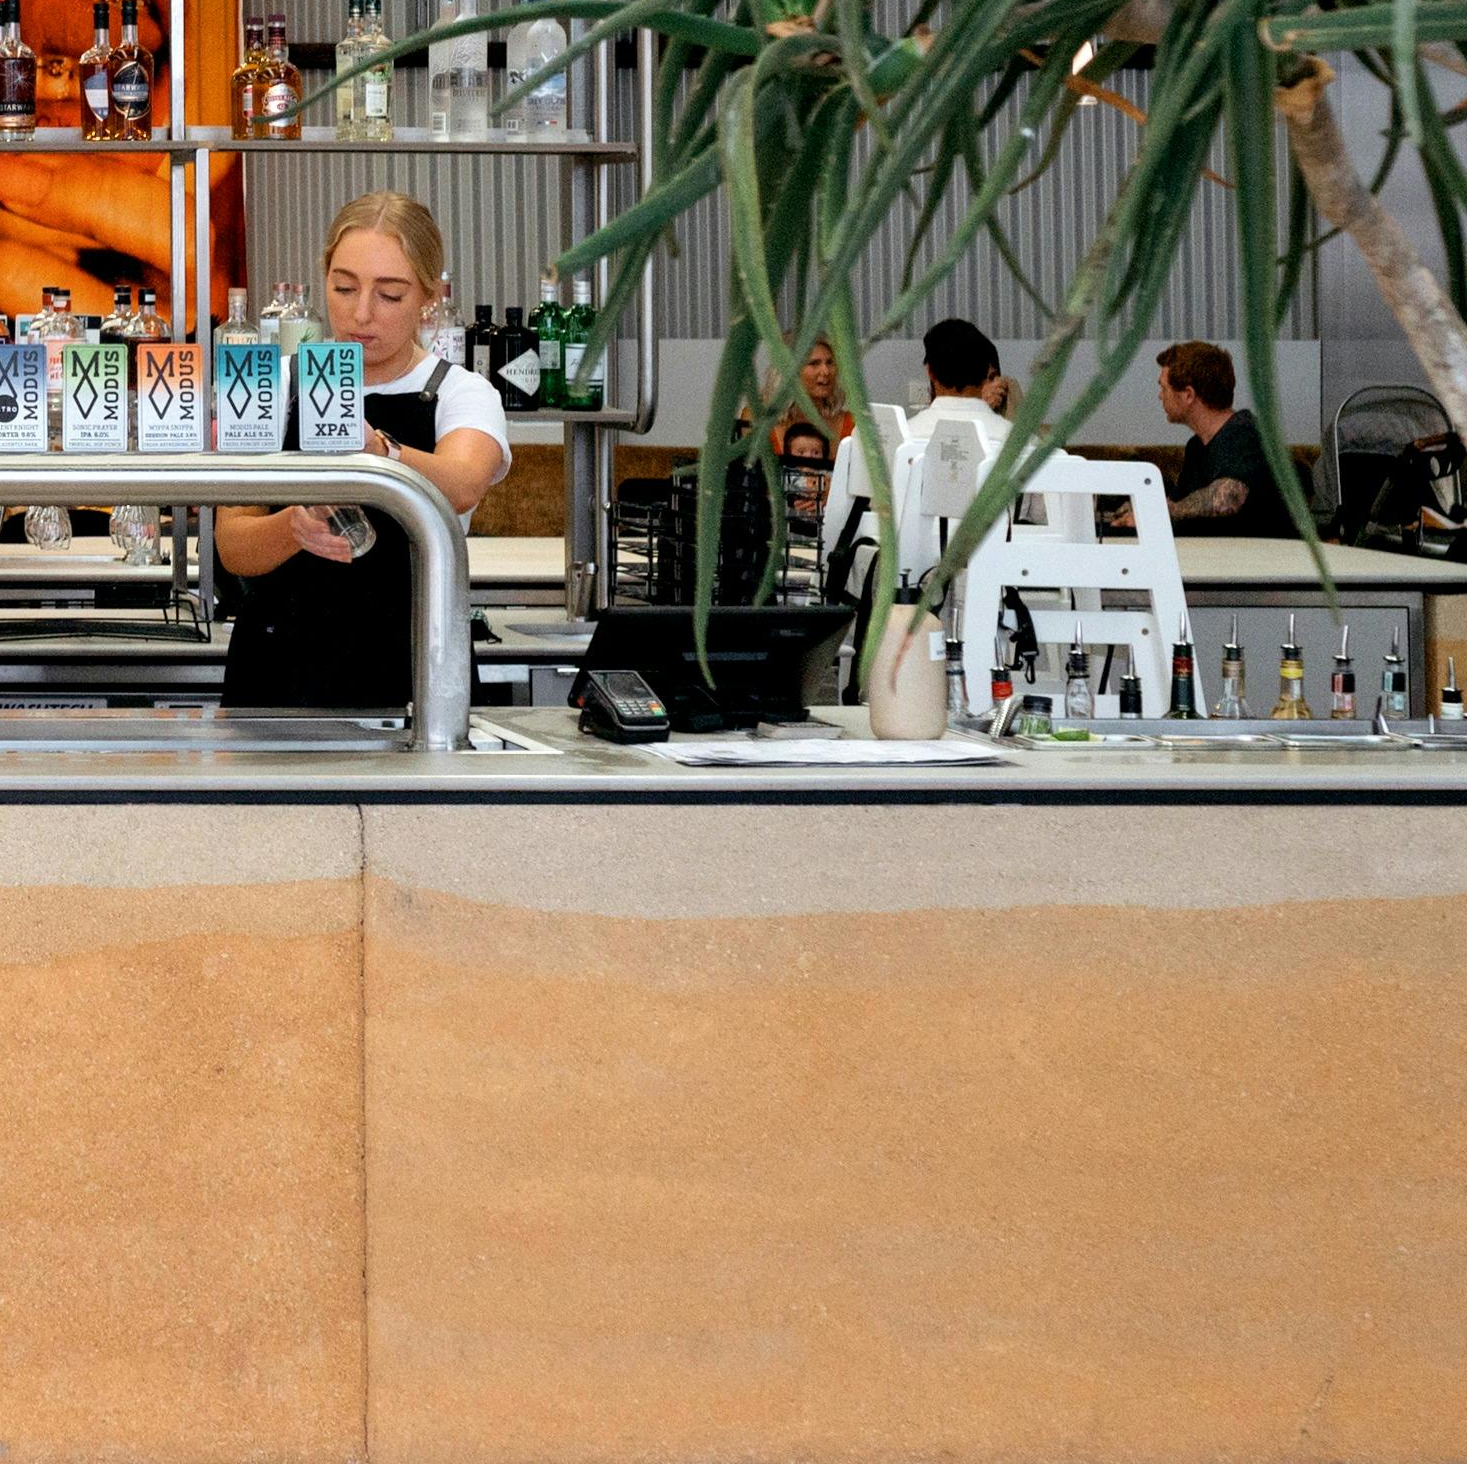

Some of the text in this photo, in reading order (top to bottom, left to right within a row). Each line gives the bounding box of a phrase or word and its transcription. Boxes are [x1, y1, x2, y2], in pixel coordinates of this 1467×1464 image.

[24, 351, 38, 420] MODUS
[104, 351, 120, 420] MODUS
[179, 351, 194, 420] MODUS
[257, 351, 272, 420] MODUS
[340, 349, 355, 418] MODUS
[315, 423, 350, 436] XPA
